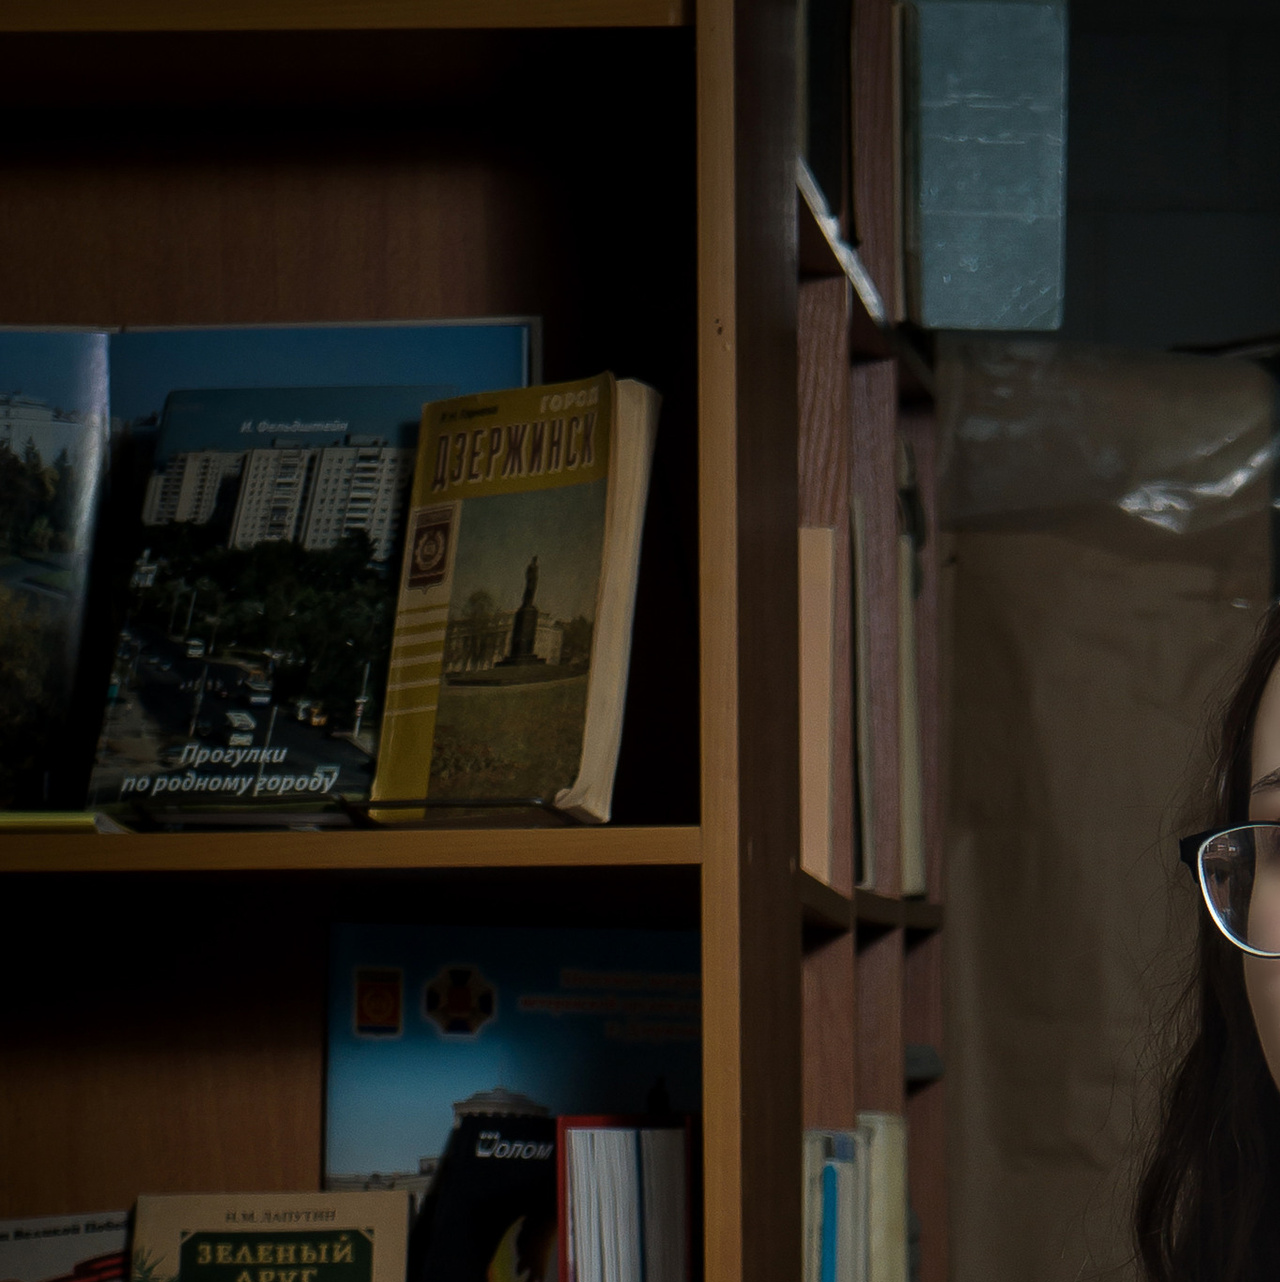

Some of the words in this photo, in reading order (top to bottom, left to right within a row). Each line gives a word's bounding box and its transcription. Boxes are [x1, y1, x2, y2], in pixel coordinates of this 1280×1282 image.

[431, 411, 599, 493] ДЗЕРЖИНСК
[180, 743, 289, 769] Прогулки
[120, 775, 150, 793] по
[151, 771, 254, 797] родному
[253, 770, 340, 796] городу
[196, 1234, 354, 1265] ЗЕЛЕНЫЙ
